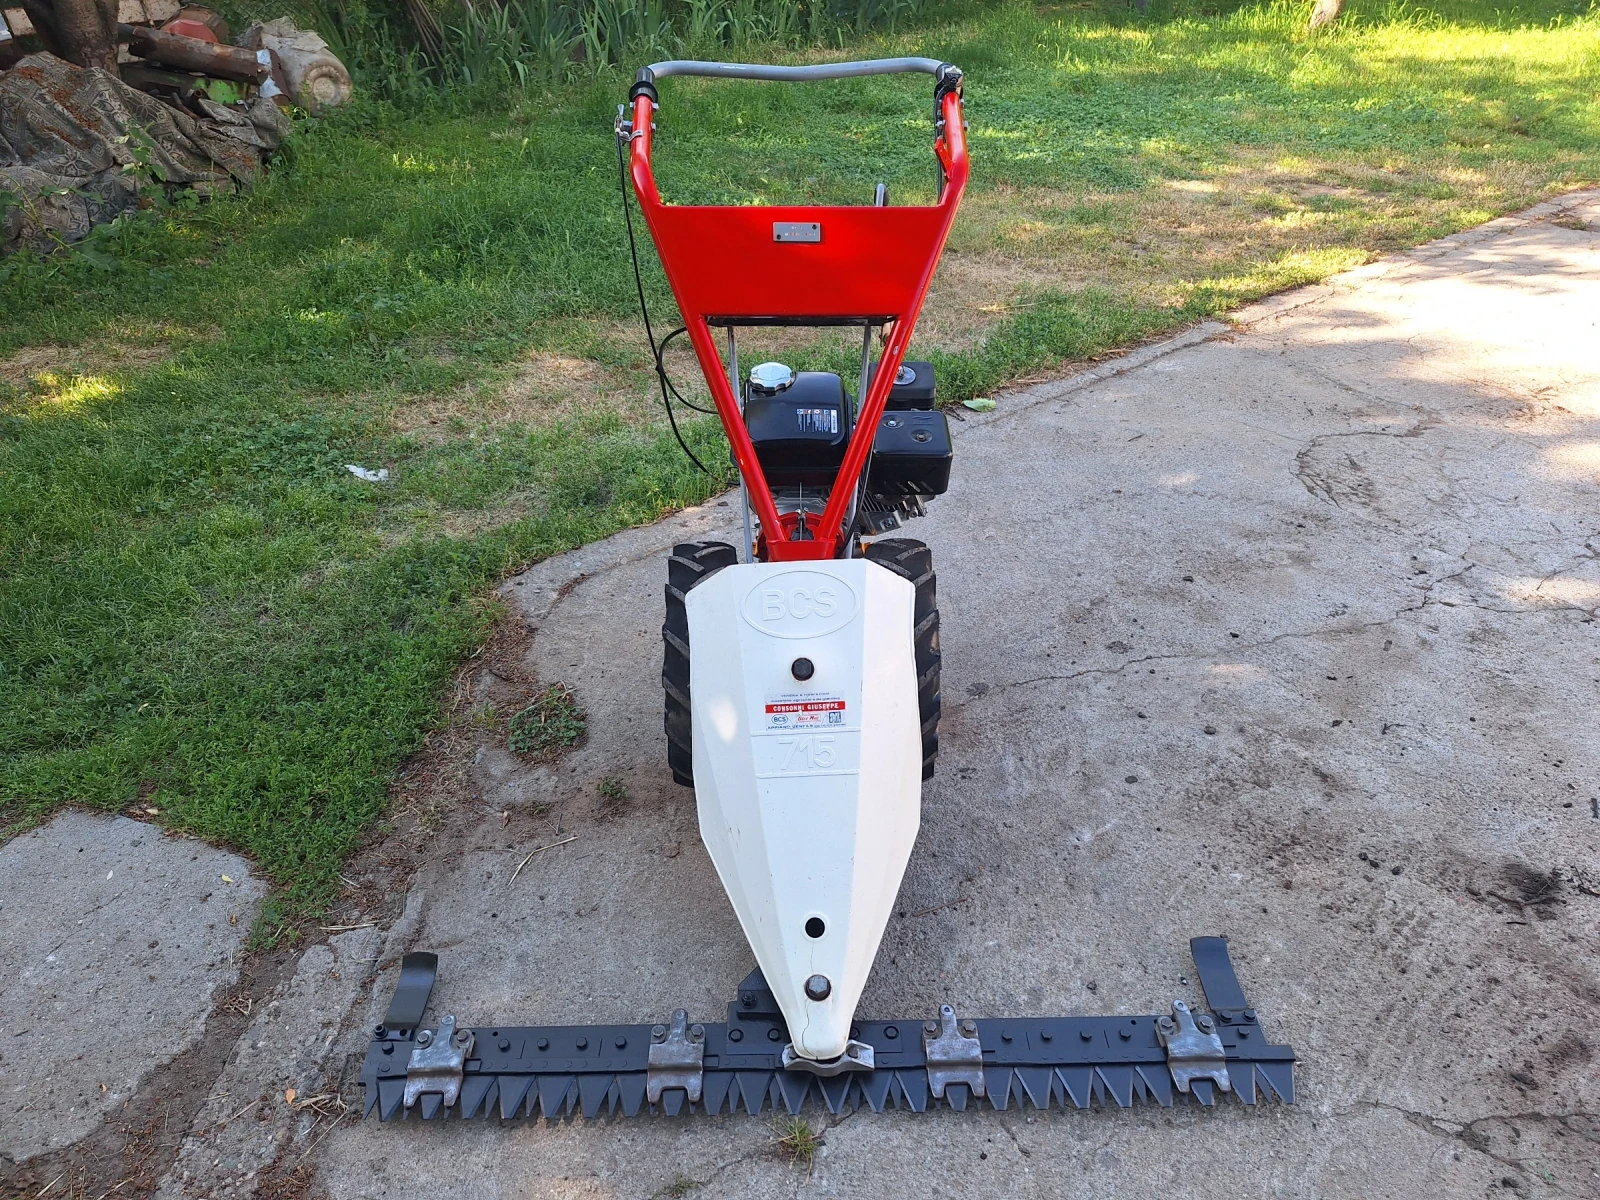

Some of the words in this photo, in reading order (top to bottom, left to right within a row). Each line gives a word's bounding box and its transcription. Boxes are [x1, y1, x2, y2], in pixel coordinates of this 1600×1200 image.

[761, 586, 837, 621] BCS
[807, 702, 839, 710] GIUSEPPE
[778, 735, 836, 770] 715
